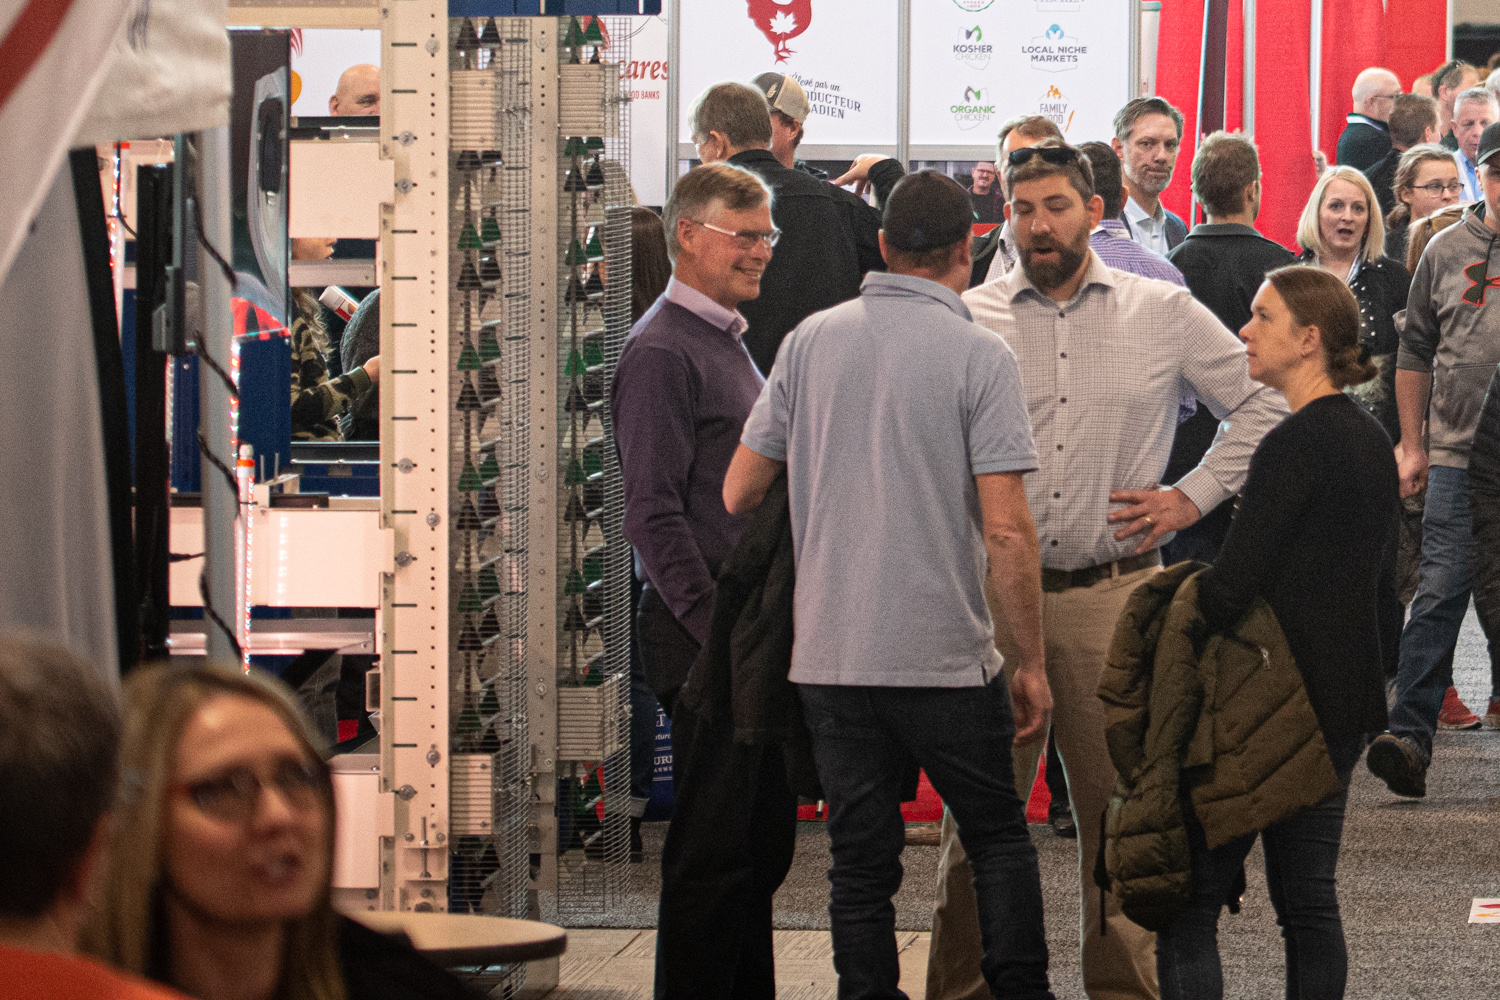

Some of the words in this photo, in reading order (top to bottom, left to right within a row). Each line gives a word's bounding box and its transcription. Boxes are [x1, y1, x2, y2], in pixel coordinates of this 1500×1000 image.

[953, 44, 993, 54] KOSHER
[1021, 46, 1054, 54] LOCAL
[1057, 46, 1087, 54] NICHE
[955, 53, 991, 61] CHICKEN
[1030, 55, 1078, 63] MARKETS
[641, 90, 660, 100] BANKS
[805, 91, 861, 112] DUCTEUR
[950, 105, 996, 114] ORGANIC
[1039, 103, 1067, 114] FAMILY
[954, 113, 990, 121] CHICKEN
